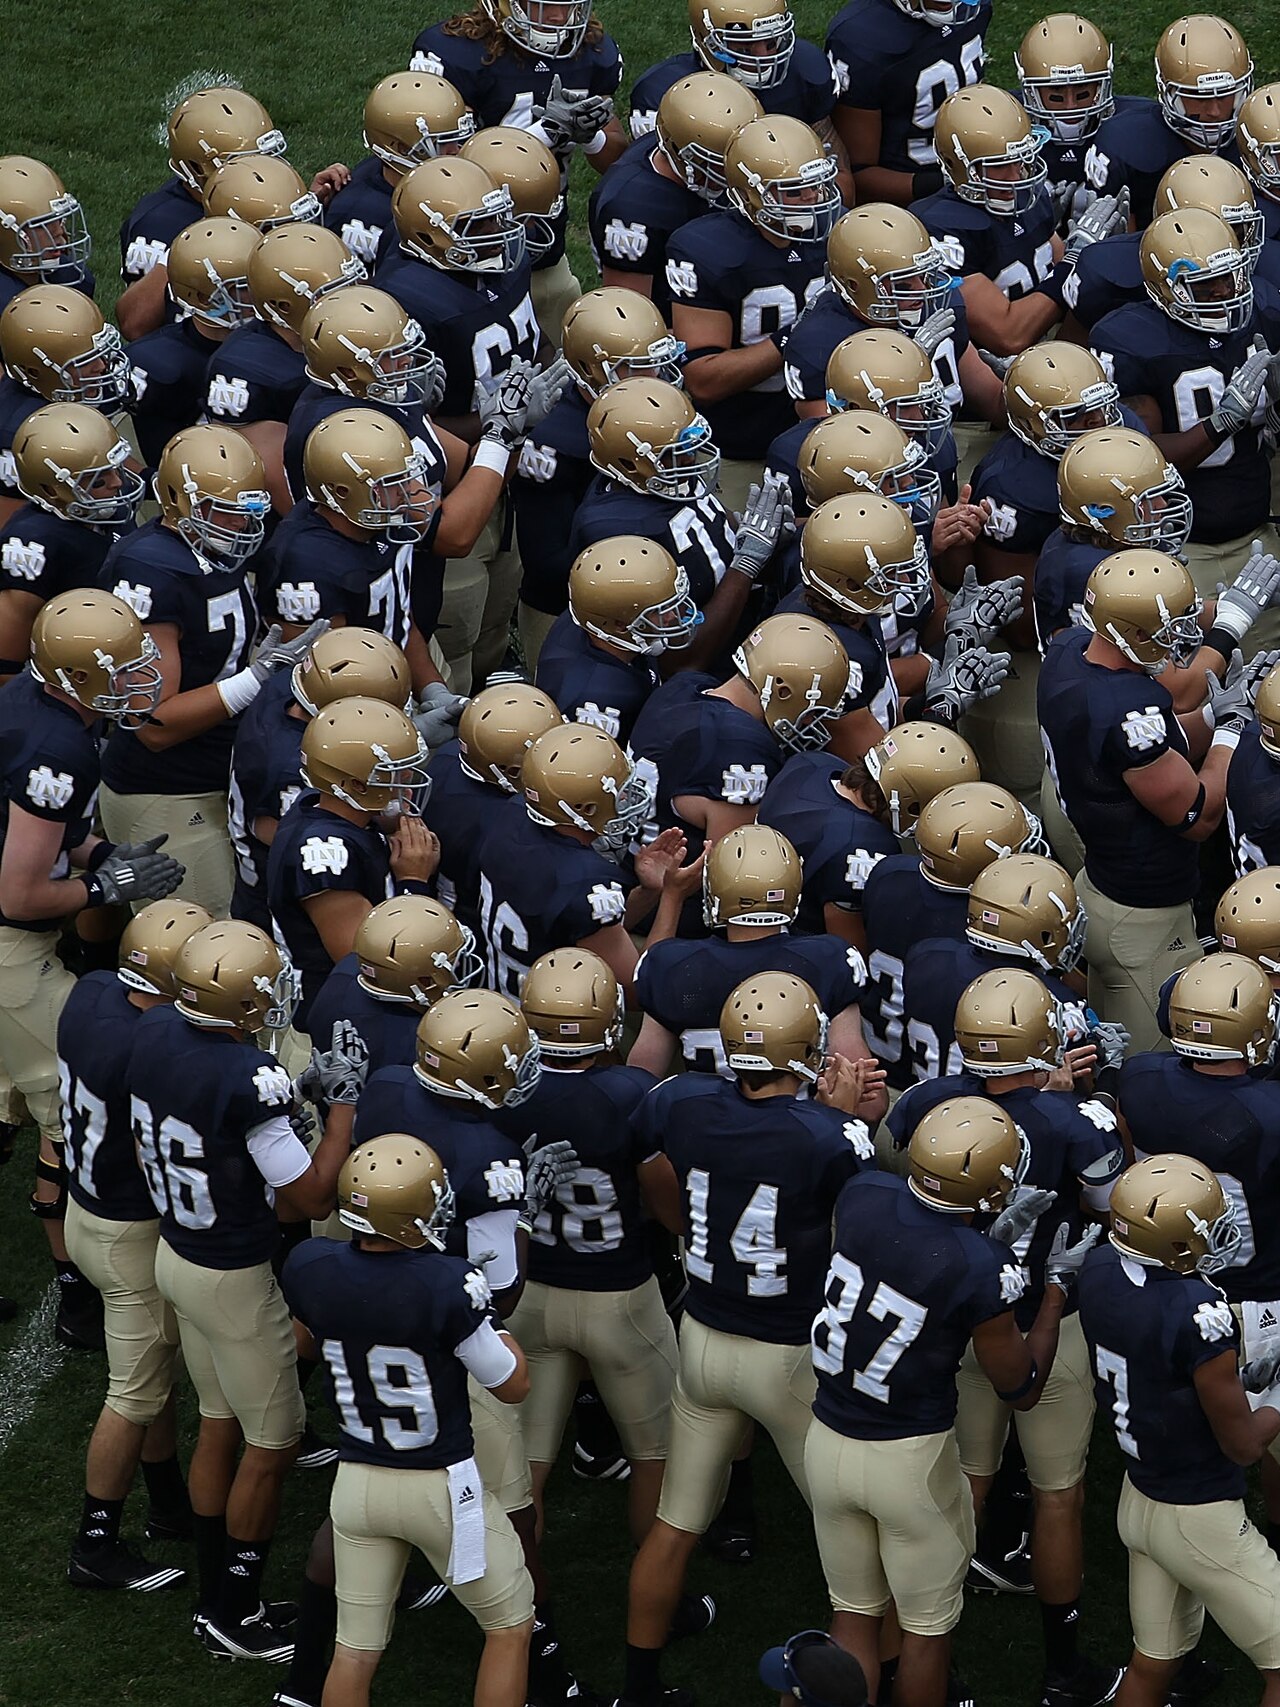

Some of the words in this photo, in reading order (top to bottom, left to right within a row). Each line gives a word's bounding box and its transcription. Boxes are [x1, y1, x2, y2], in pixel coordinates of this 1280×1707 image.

[1214, 251, 1230, 260] IRISH
[742, 915, 784, 923] IRISH
[685, 1167, 788, 1298] 14
[811, 1252, 929, 1404] 87
[321, 1338, 440, 1452] 19
[1095, 1343, 1142, 1461] 7
